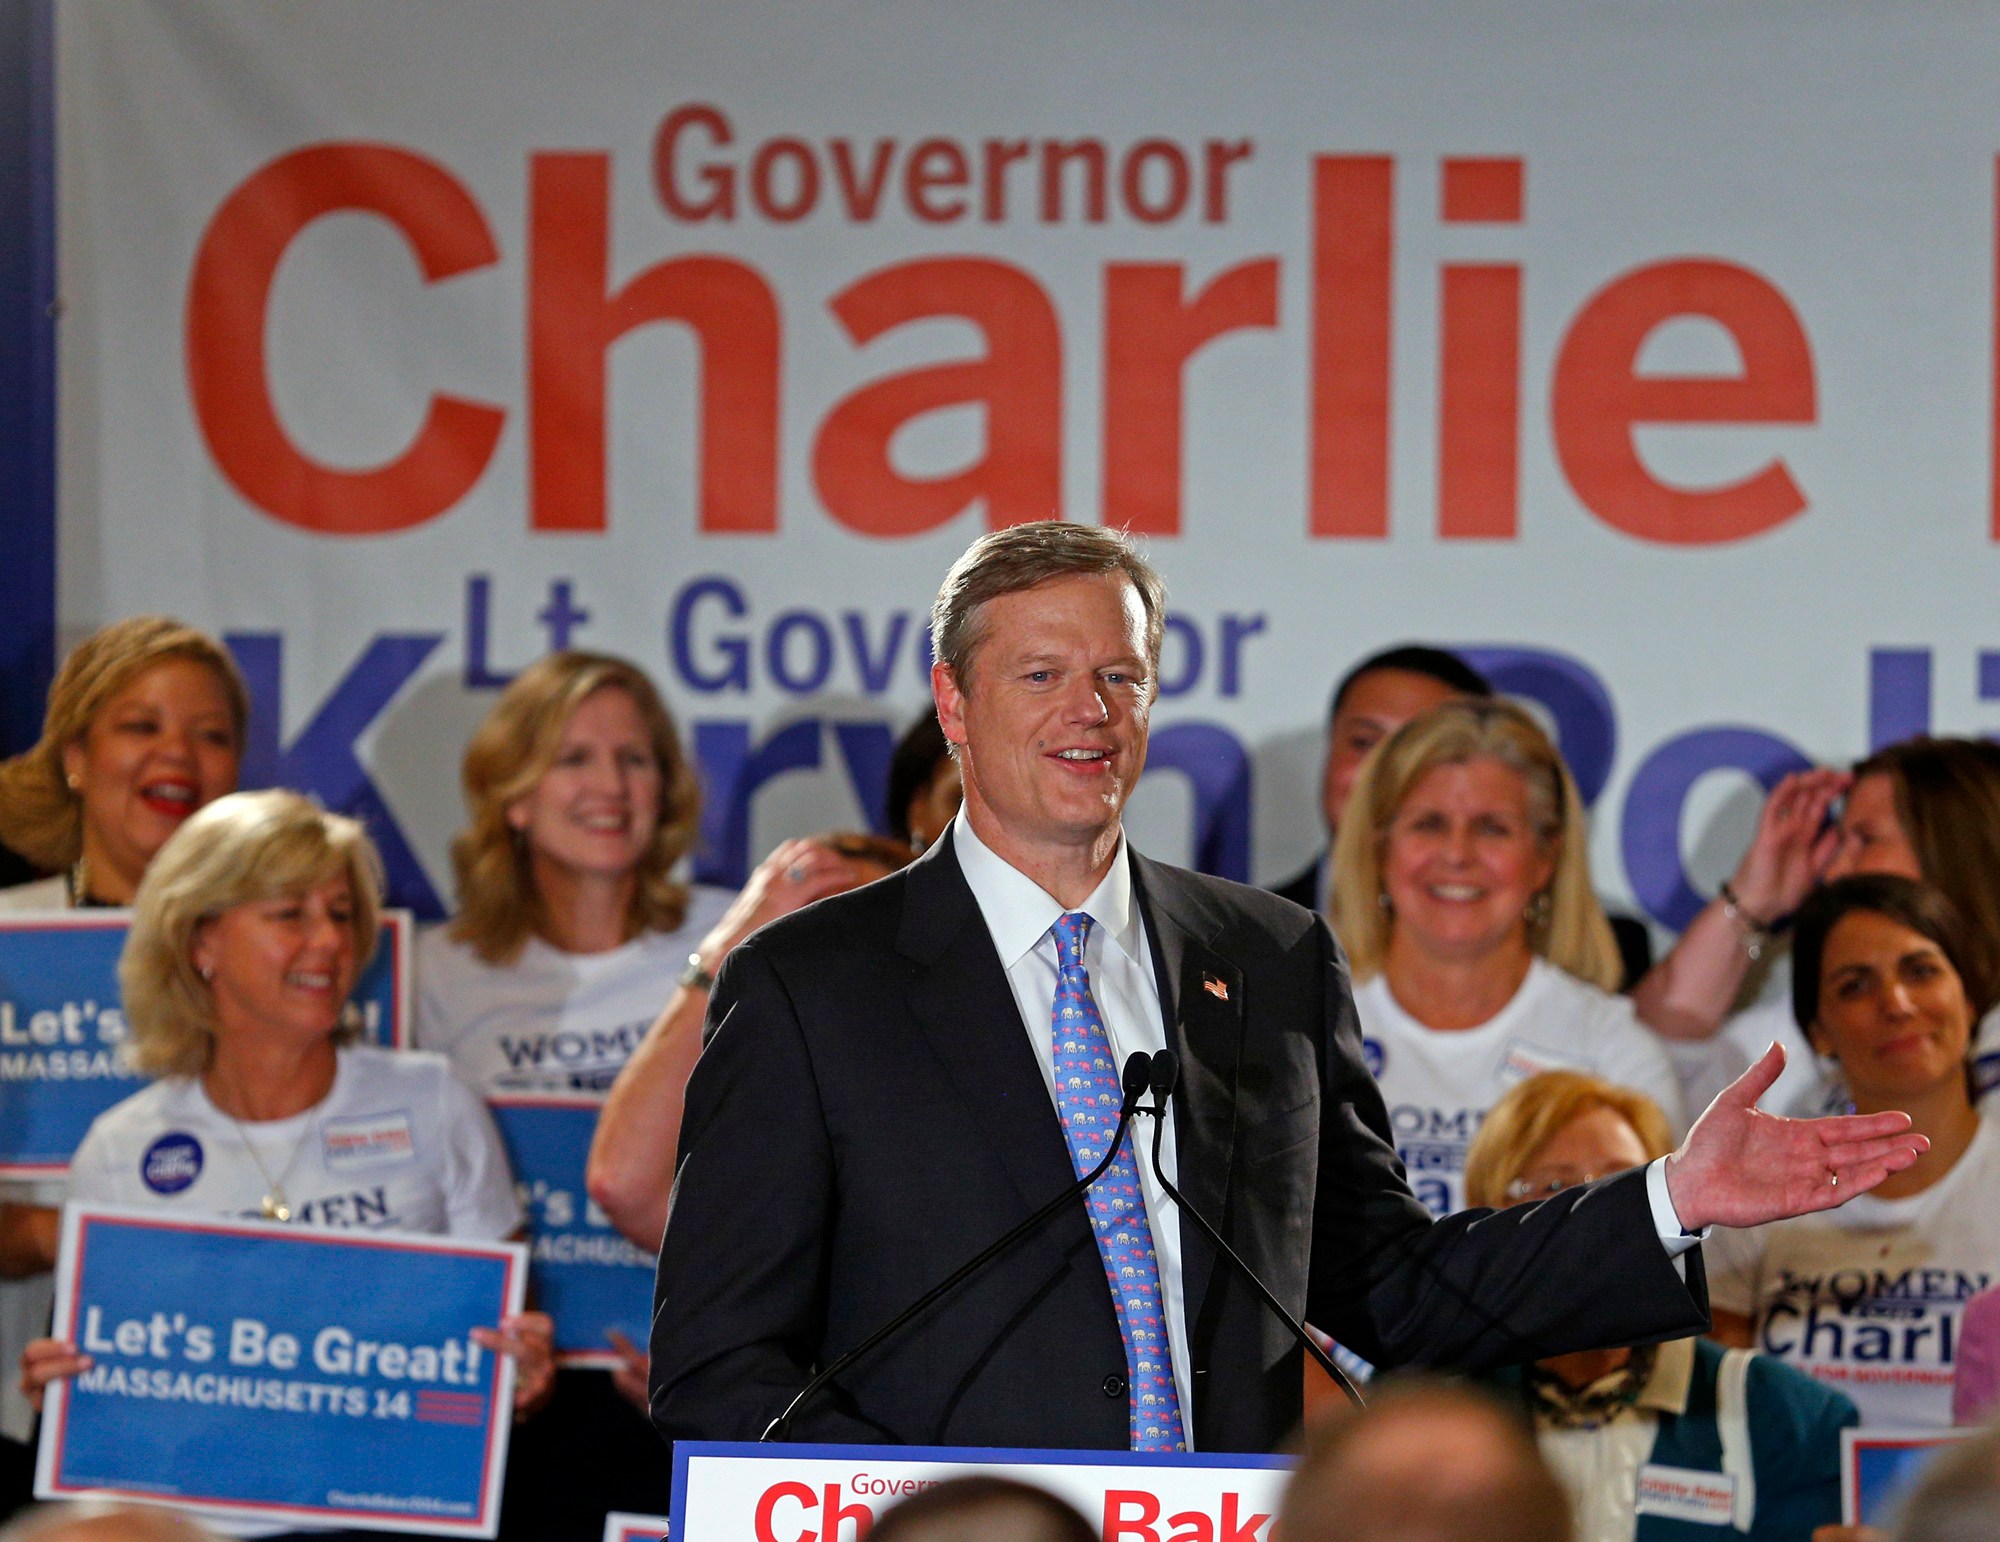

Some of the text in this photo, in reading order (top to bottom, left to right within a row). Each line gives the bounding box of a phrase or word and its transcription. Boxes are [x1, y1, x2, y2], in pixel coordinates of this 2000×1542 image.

[651, 102, 1256, 227] Governor
[184, 139, 1820, 550] Charlie
[464, 574, 1267, 697] Lt Govor
[220, 630, 1254, 924] Krn
[2, 1000, 128, 1047] Let's
[83, 1305, 484, 1386] Let's Be Great!
[1763, 1302, 1953, 1365] Charl
[77, 1362, 412, 1420] MASSACHUSETTS 14
[754, 1480, 1284, 1542] Ch Bak
